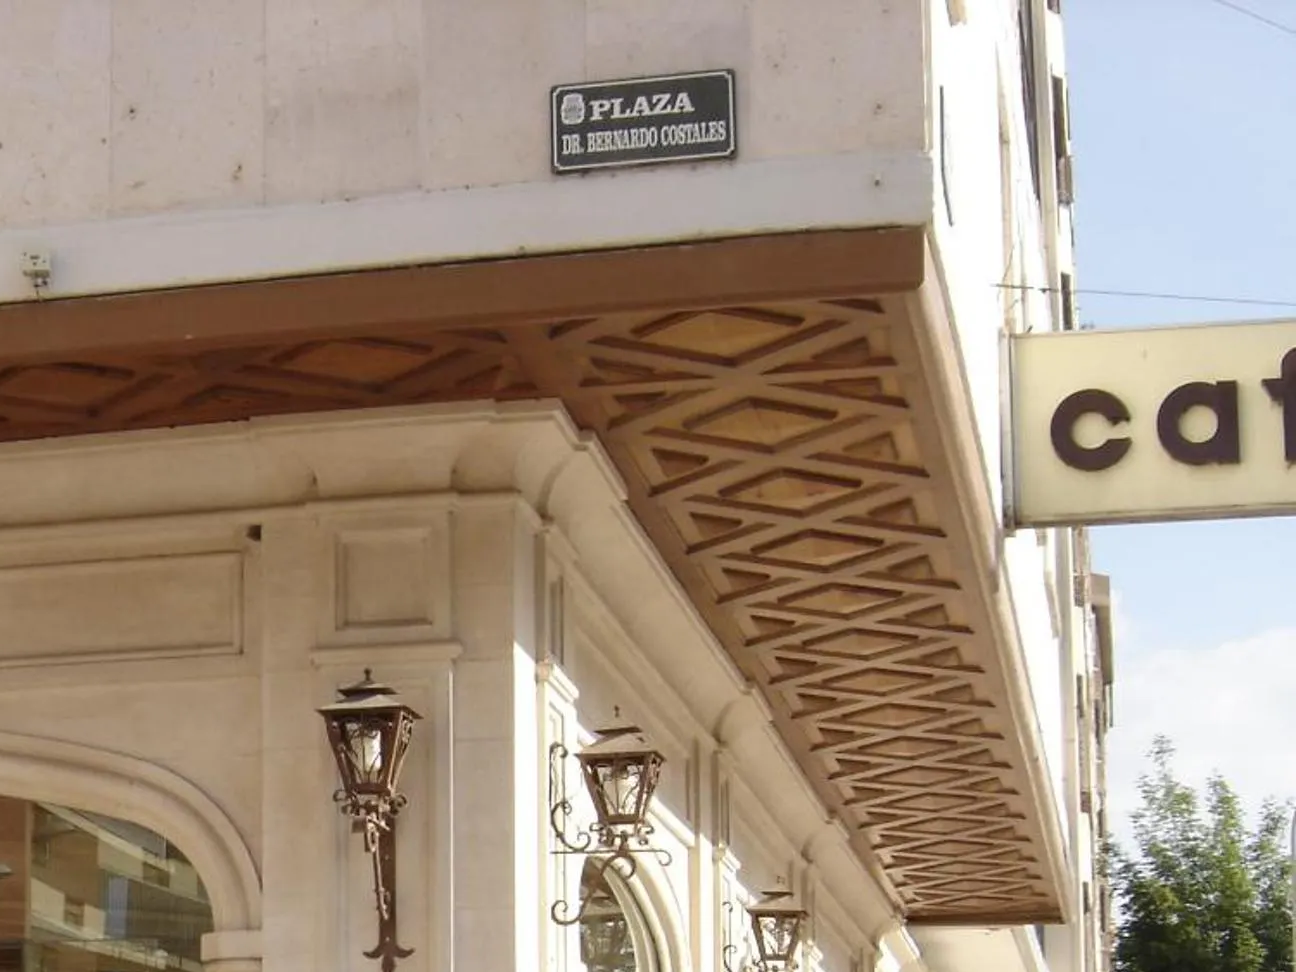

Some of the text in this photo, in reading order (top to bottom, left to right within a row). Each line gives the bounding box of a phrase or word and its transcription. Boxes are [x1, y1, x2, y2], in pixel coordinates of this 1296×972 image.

[589, 92, 695, 121] PLAZA
[561, 120, 726, 155] DR. BERNARDO COSTALES
